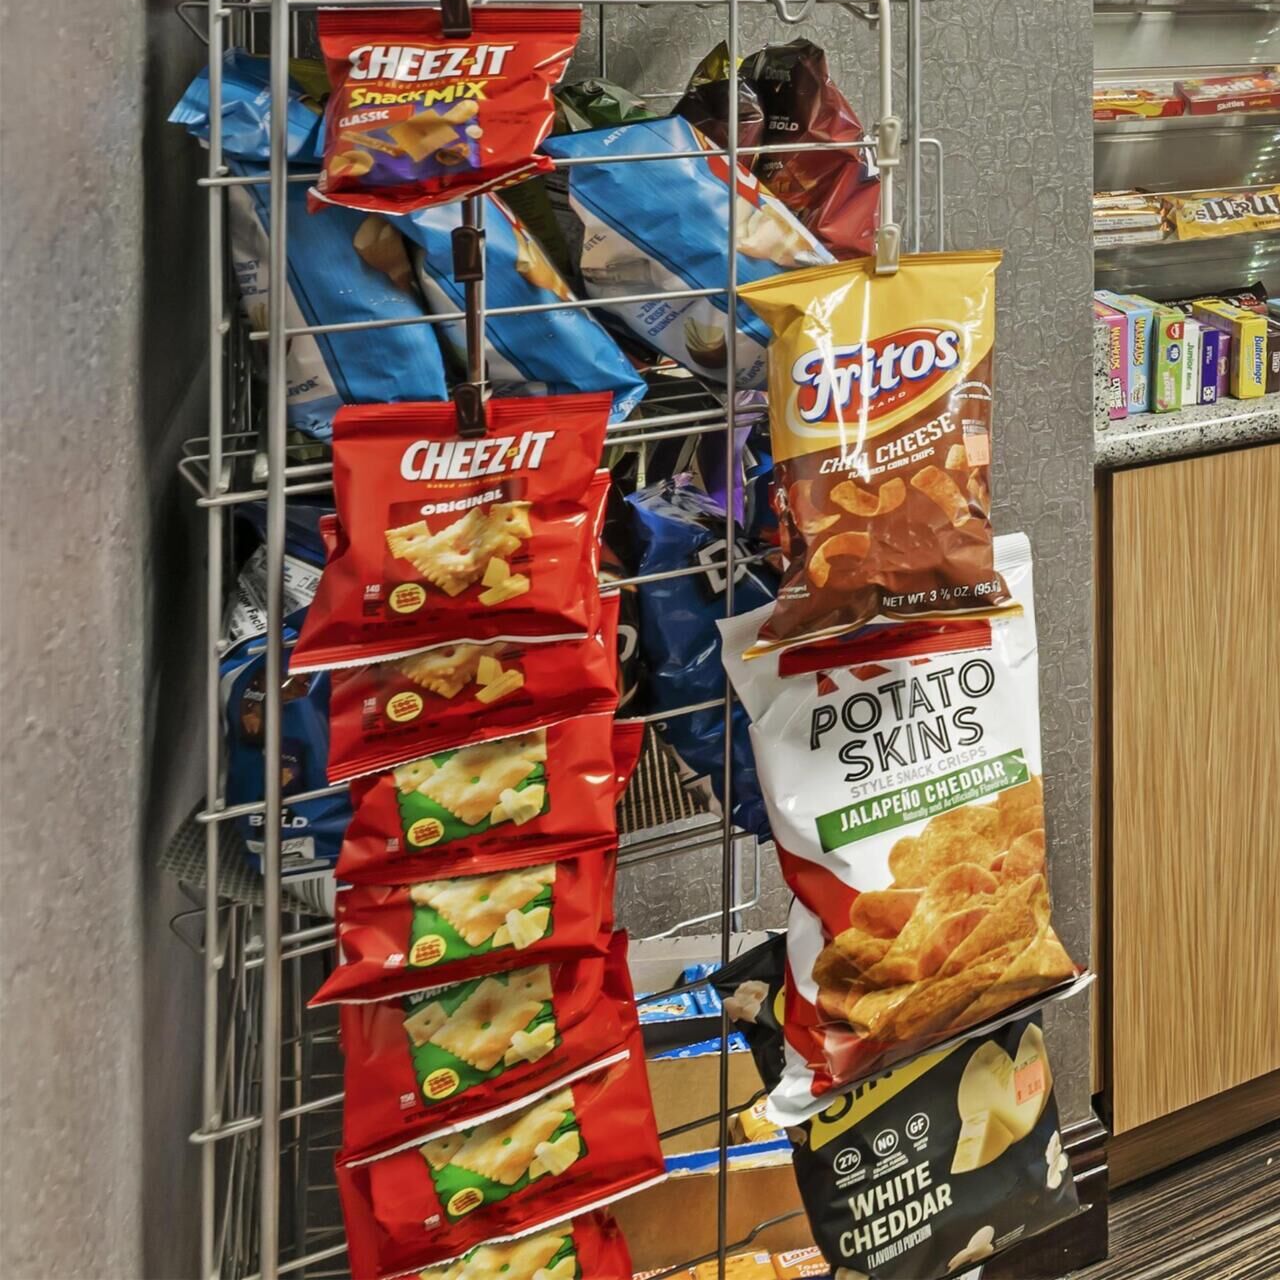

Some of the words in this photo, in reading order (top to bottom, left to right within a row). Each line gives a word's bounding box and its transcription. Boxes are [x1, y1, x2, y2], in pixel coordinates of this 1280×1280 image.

[348, 44, 515, 82] CHEEZ-IT
[338, 110, 390, 128] CLASSIC
[768, 119, 799, 132] BOLD
[1216, 99, 1245, 111] Skittles
[644, 303, 672, 326] CRISPY
[1110, 326, 1121, 370] WARHEADS
[1133, 317, 1147, 366] WARHEADS
[1186, 342, 1194, 371] Junior
[1253, 335, 1264, 385] Butterfinger
[791, 327, 961, 424] Fritos
[400, 430, 556, 481] CHEEZ-IT
[876, 412, 956, 464] CHEESE
[911, 447, 935, 463] CHIPS
[420, 488, 503, 516] ORIGINAL
[882, 596, 904, 608] NET
[908, 593, 927, 605] WT.
[929, 590, 937, 602] 3
[953, 586, 971, 598] OZ.
[810, 658, 996, 751] POTATO
[838, 706, 984, 782] SKINS
[850, 772, 895, 798] STYLE
[896, 764, 935, 785] SNACK
[937, 746, 988, 773] CRISPS
[840, 789, 921, 832] JALAPEÑO
[926, 760, 1006, 804] CHEDDAR
[249, 815, 309, 829] BLD
[877, 1134, 894, 1152] NO
[910, 1118, 925, 1135] GF
[848, 1160, 933, 1221] WHITE
[839, 1183, 954, 1258] CHEDDAR
[867, 1234, 903, 1270] FLAVORED
[903, 1223, 933, 1249] POPCORN
